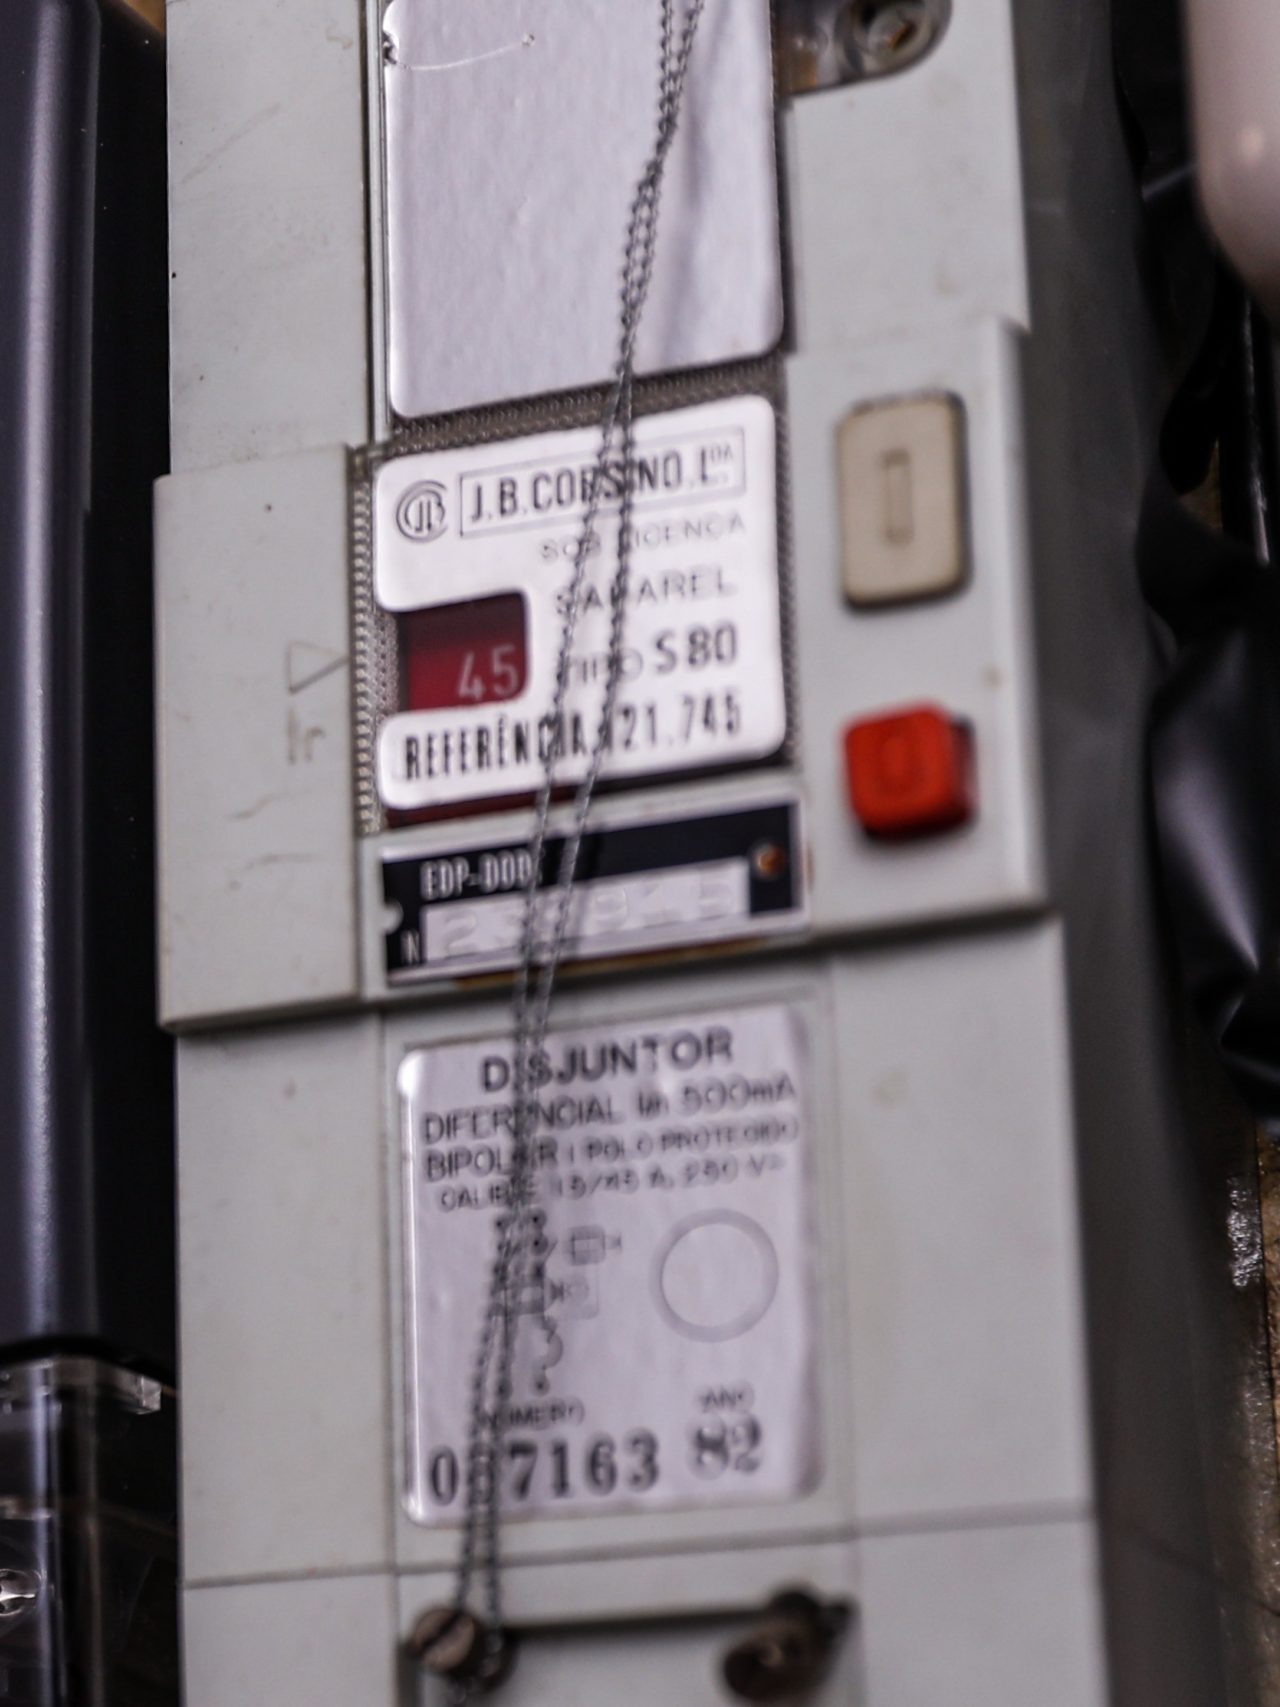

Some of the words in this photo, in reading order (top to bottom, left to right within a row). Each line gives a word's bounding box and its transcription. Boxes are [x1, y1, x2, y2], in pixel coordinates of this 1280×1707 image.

[553, 564, 739, 620] SAAREL
[457, 643, 520, 701] 45
[404, 711, 588, 782] REFERÊNCA
[482, 1025, 733, 1094] DSJUNTOR
[424, 1093, 624, 1144] DIFERNCIAL
[426, 1134, 559, 1183] BIPOLR
[428, 1425, 661, 1506] 07163
